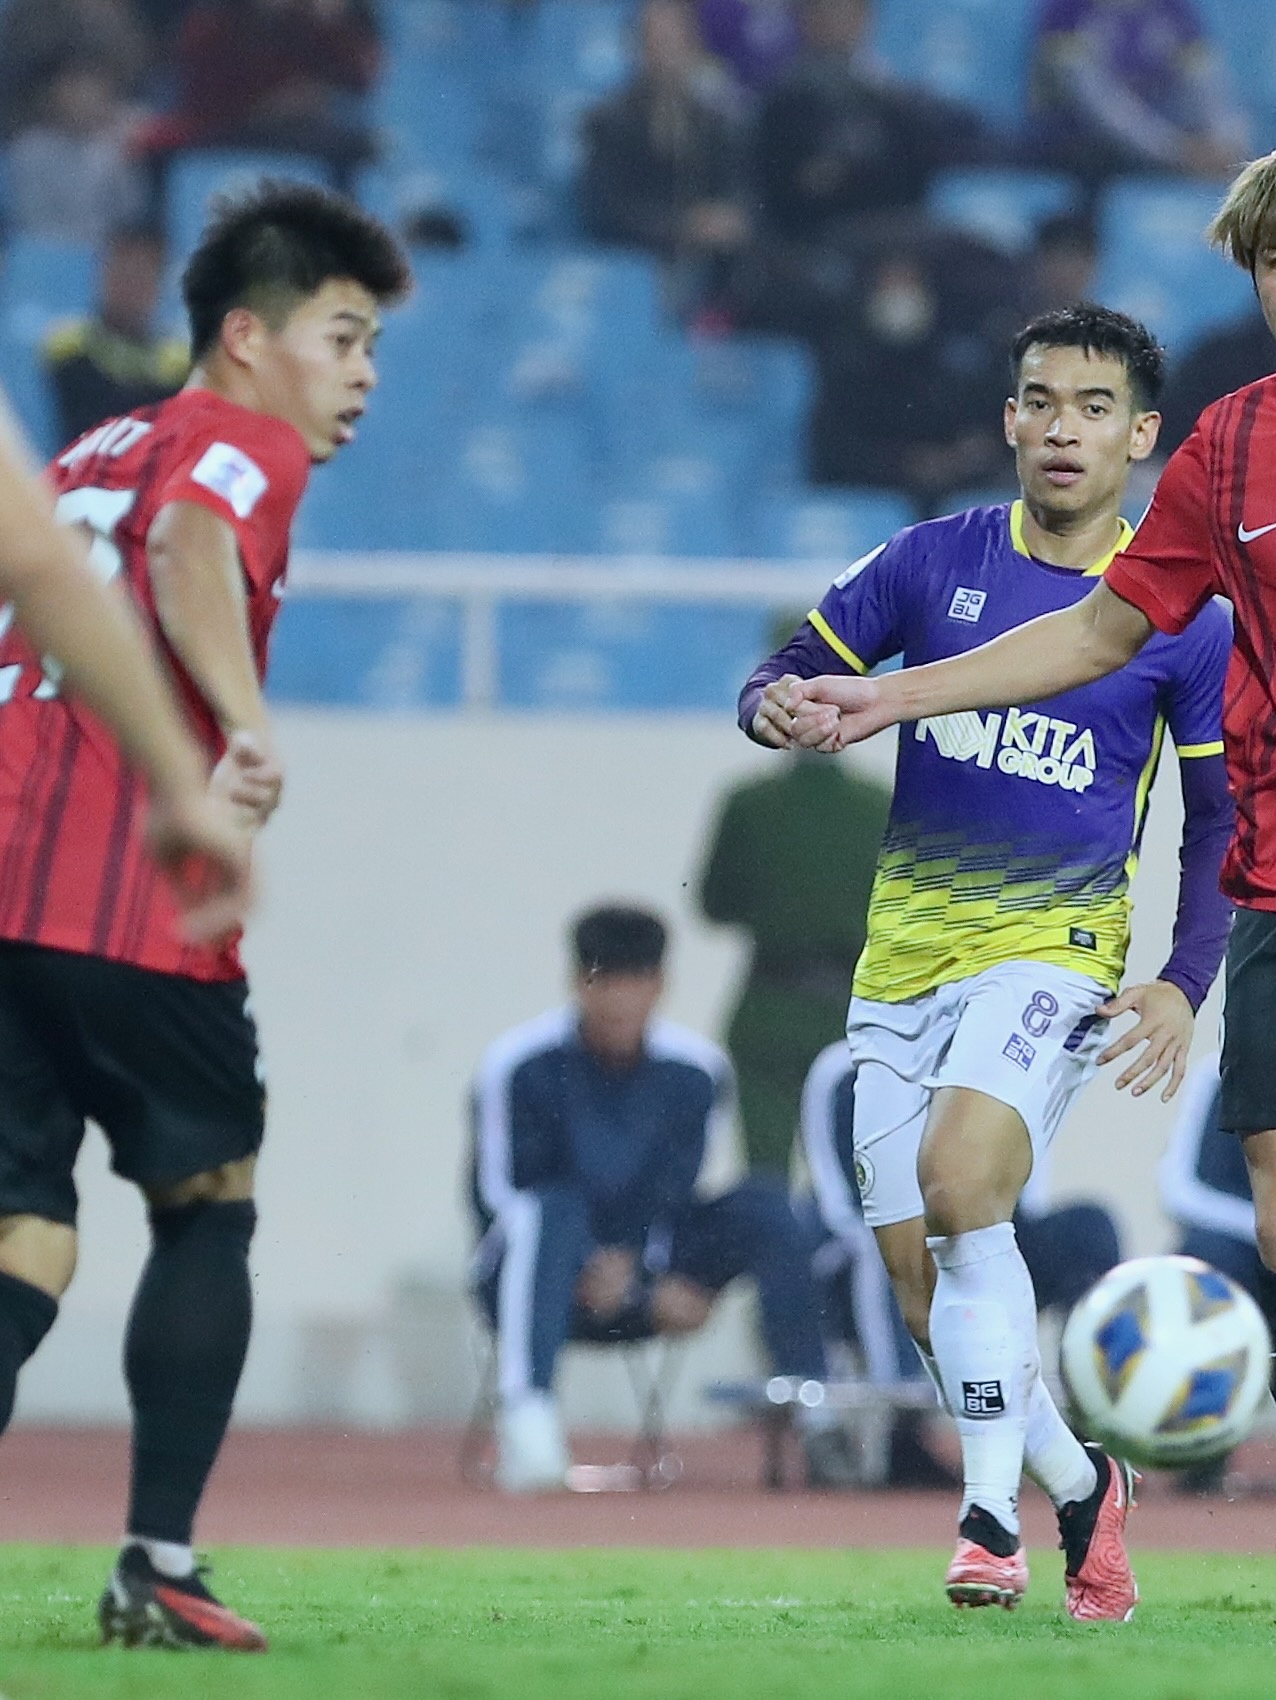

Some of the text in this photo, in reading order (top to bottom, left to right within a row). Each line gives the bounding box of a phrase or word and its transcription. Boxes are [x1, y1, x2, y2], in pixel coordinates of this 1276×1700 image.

[956, 592, 982, 605] JG
[952, 603, 976, 618] BL
[1001, 706, 1097, 770] KITA
[997, 747, 1095, 794] GROUP
[1022, 989, 1059, 1038] 8
[966, 1382, 999, 1398] JG
[966, 1397, 1002, 1412] BL
